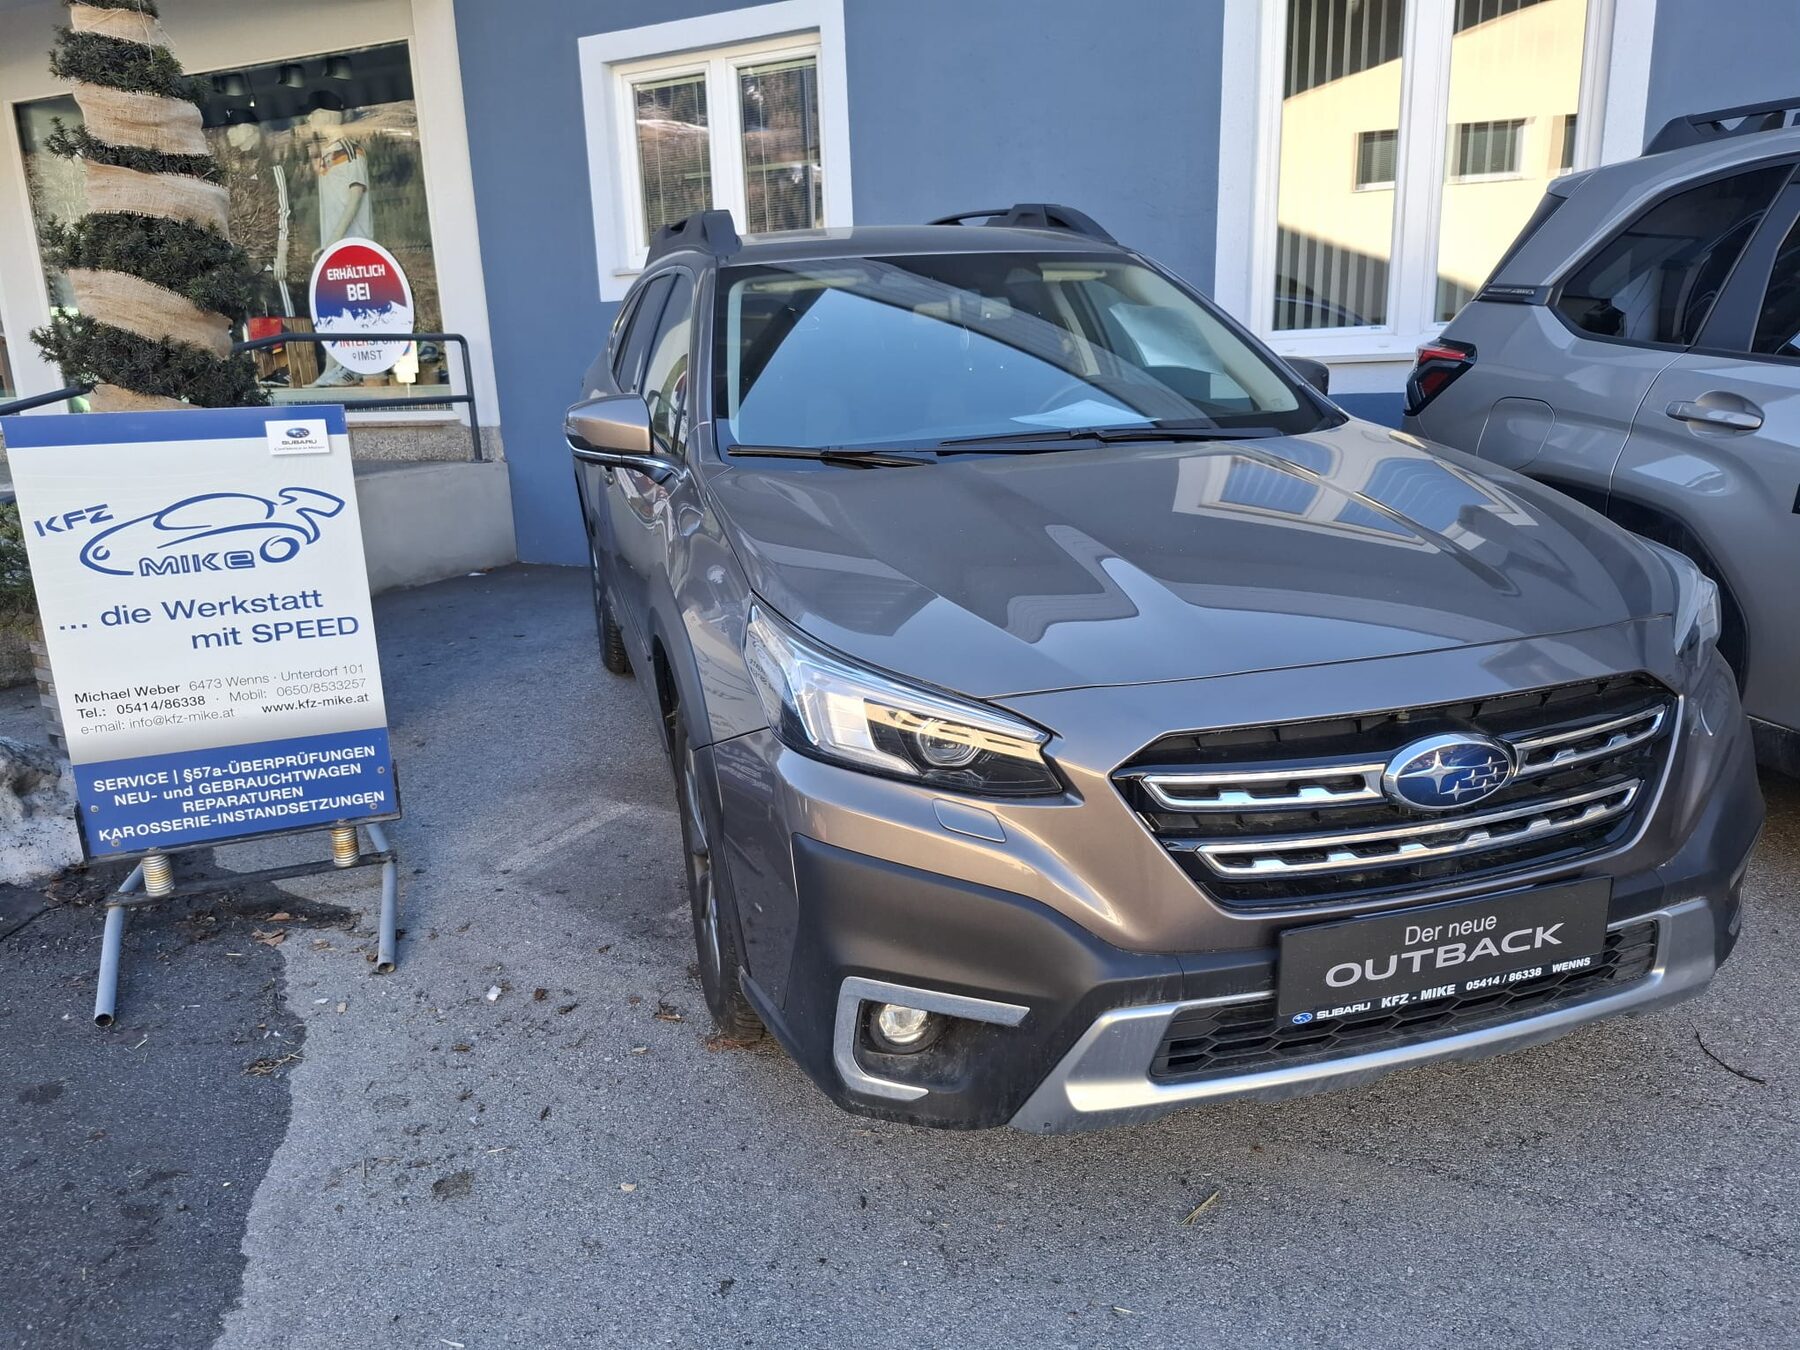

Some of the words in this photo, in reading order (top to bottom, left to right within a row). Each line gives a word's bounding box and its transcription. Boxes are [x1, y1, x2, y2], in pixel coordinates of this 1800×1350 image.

[327, 264, 386, 280] ERHÄLTLICH
[346, 283, 371, 302] BEI
[358, 350, 383, 361] IMST
[33, 503, 114, 537] KFZ
[100, 604, 152, 627] die
[161, 589, 324, 621] Werkstatt
[191, 627, 243, 650] mit
[252, 616, 360, 644] SPEED
[74, 688, 130, 704] Michael
[134, 683, 181, 697] Weber
[188, 678, 222, 691] 6473
[225, 674, 270, 688] Wenns
[280, 666, 338, 682] Unterdorf
[342, 664, 364, 675] 101
[77, 707, 107, 720] Tel.:
[116, 695, 206, 715] 05414/86338
[229, 689, 267, 702] Mobil:
[276, 678, 366, 697] 0650/8533257
[80, 720, 125, 735] e-mail:
[128, 708, 235, 729] info@kfz-mike.at
[261, 693, 369, 713] www.kfz-mike.at
[93, 771, 169, 792] SERVICE
[183, 745, 376, 783] §57a-ÜBERPRÜFUNGEN
[114, 790, 158, 806] NEU-
[163, 785, 193, 800] und
[198, 762, 362, 795] GEBRAUCHTWAGEN
[98, 790, 385, 842] KAROSSERIE-INSTANDSETZUNGEN
[182, 785, 304, 813] REPARATUREN
[1404, 924, 1442, 946] Der
[1448, 914, 1498, 938] neue
[1325, 922, 1566, 988] OUTBACK
[1316, 1002, 1371, 1020] SUBARU
[1381, 993, 1409, 1008] KFZ
[1420, 984, 1456, 1000] MIKE
[1466, 975, 1500, 991] 05414
[1508, 967, 1542, 982] 86338
[1552, 957, 1591, 973] WENNS
